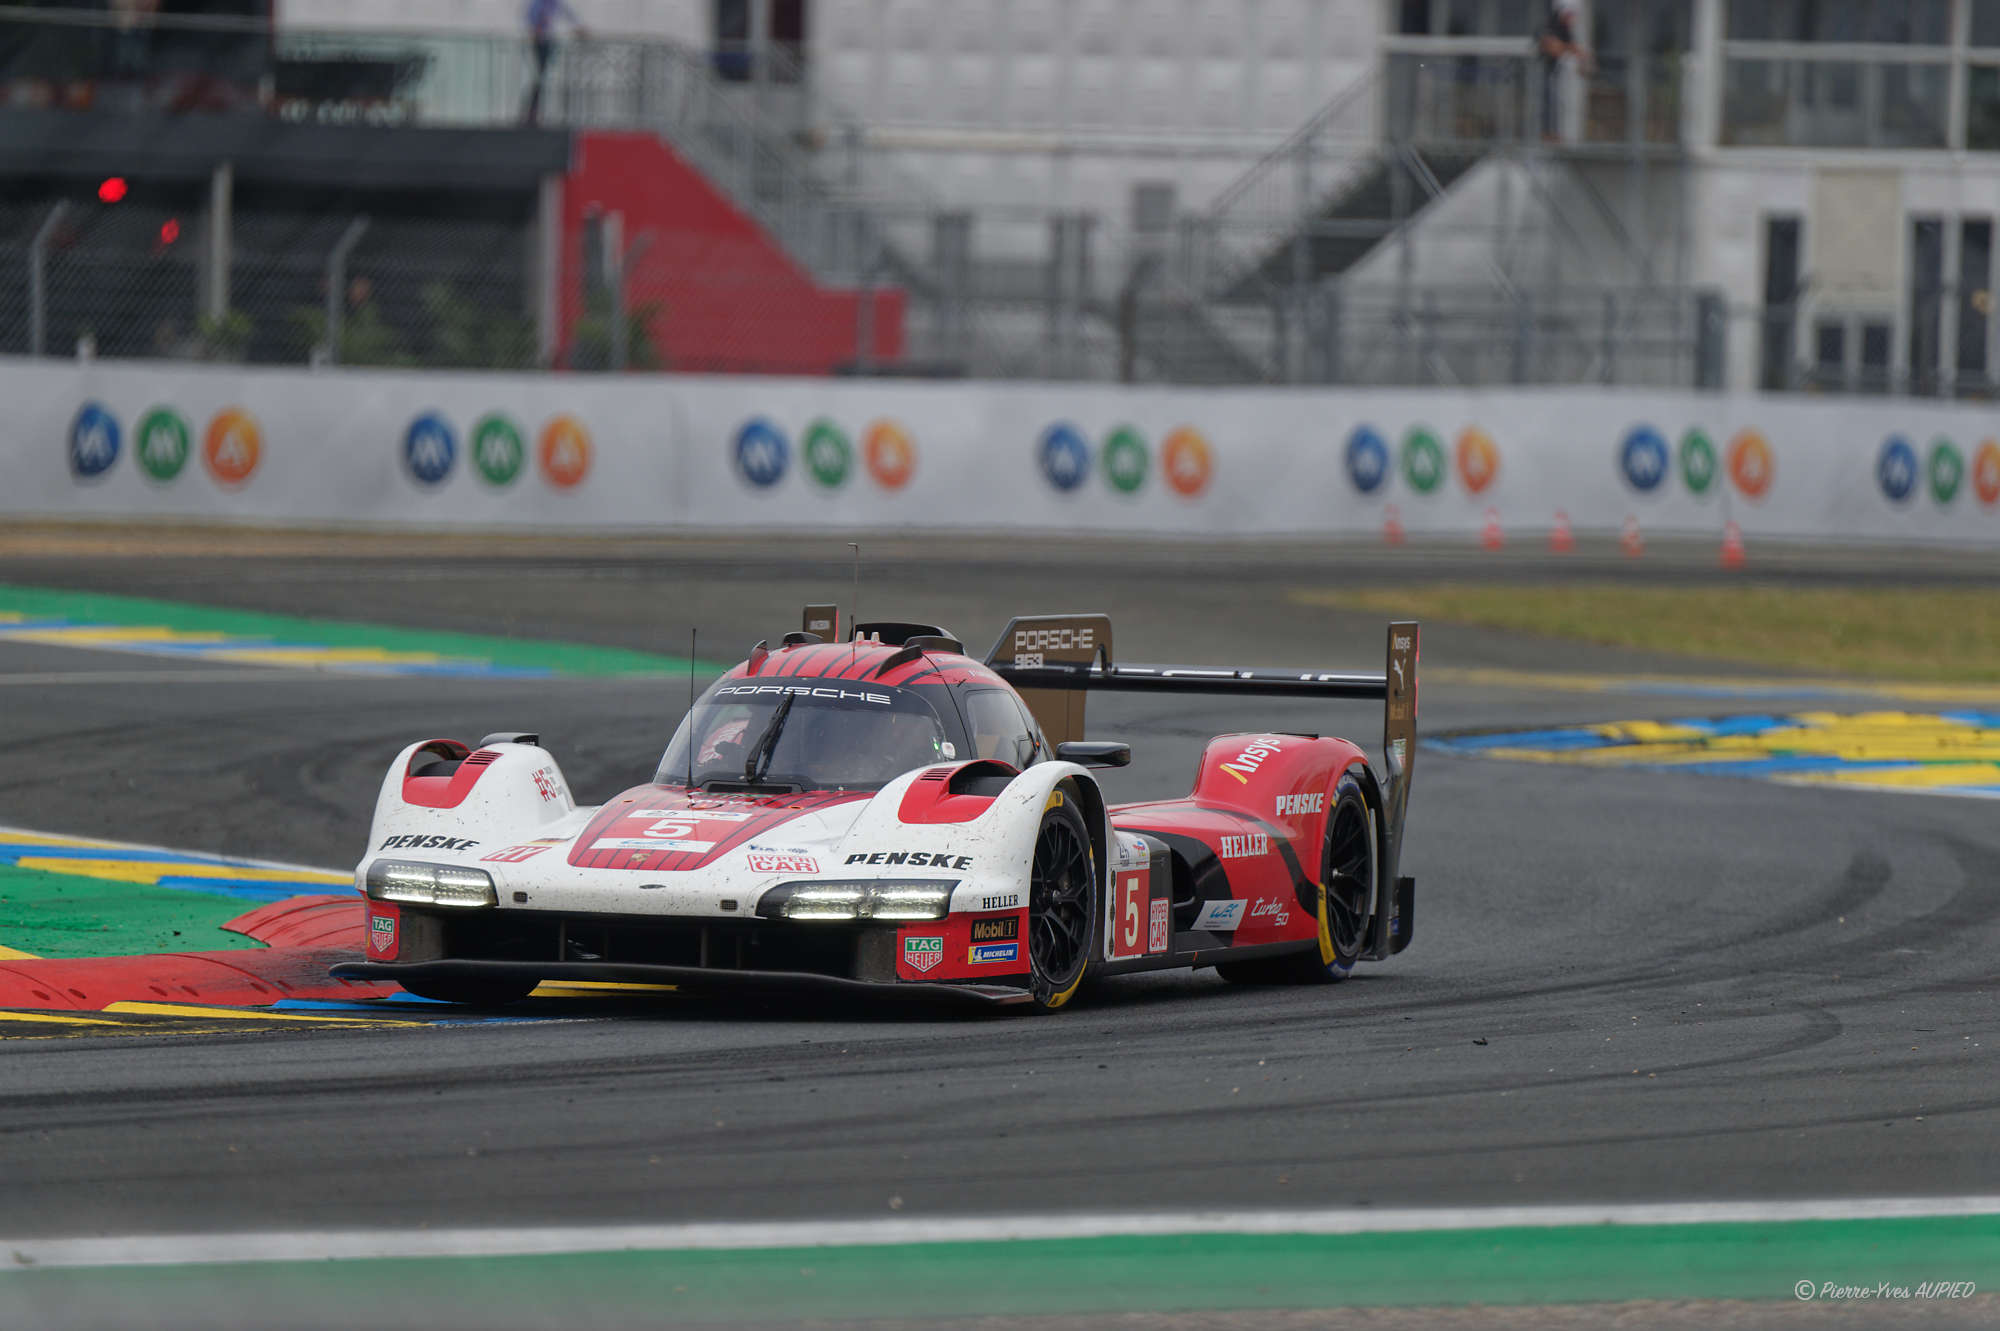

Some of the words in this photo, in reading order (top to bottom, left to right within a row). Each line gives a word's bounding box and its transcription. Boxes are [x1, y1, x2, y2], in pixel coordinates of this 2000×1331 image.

[1015, 628, 1094, 651] PORSCHE
[1014, 653, 1044, 670] 963
[715, 685, 891, 705] PORSCHE
[1275, 793, 1325, 816] PENSKE
[643, 819, 700, 838] 5
[378, 835, 480, 851] PENSKE
[1220, 833, 1268, 858] HELLER
[755, 861, 813, 872] CAR
[843, 852, 974, 870] PENSKE
[982, 895, 1019, 909] HELLER
[1125, 878, 1140, 947] 5
[1151, 903, 1168, 920] HYPER
[374, 919, 392, 931] TAG
[974, 920, 1004, 939] Mobil
[1150, 921, 1167, 948] CAR
[908, 940, 941, 950] TAG
[983, 949, 1015, 958] MICHELIN
[907, 951, 941, 969] HEUER
